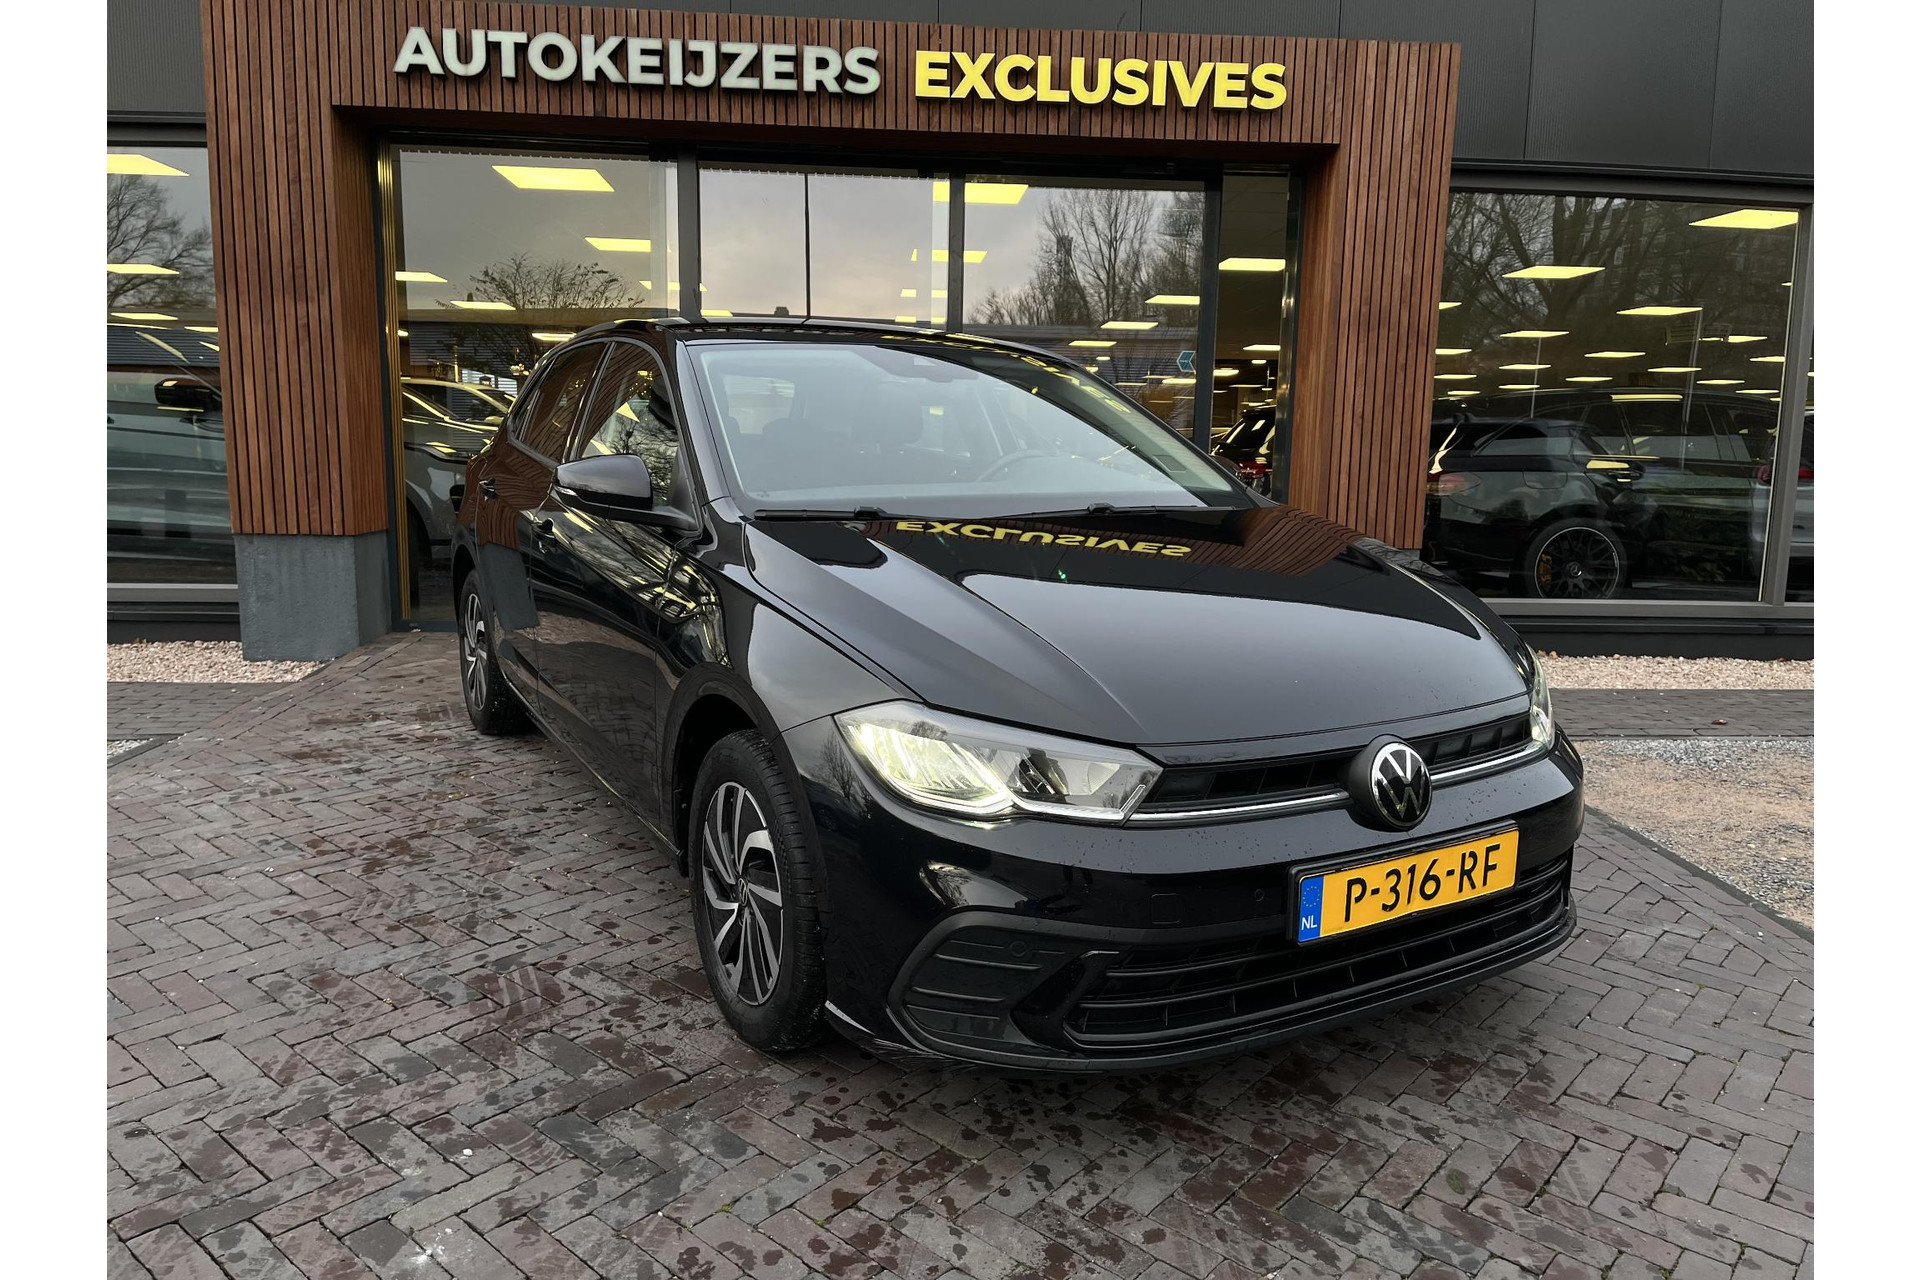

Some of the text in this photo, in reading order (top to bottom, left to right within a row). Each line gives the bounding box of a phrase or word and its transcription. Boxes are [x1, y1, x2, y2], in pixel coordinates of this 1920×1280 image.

[392, 26, 1288, 111] AUTOKEIJZERS EXCLUSIVES
[1301, 914, 1318, 931] NL
[1343, 843, 1501, 923] P-316-RF
